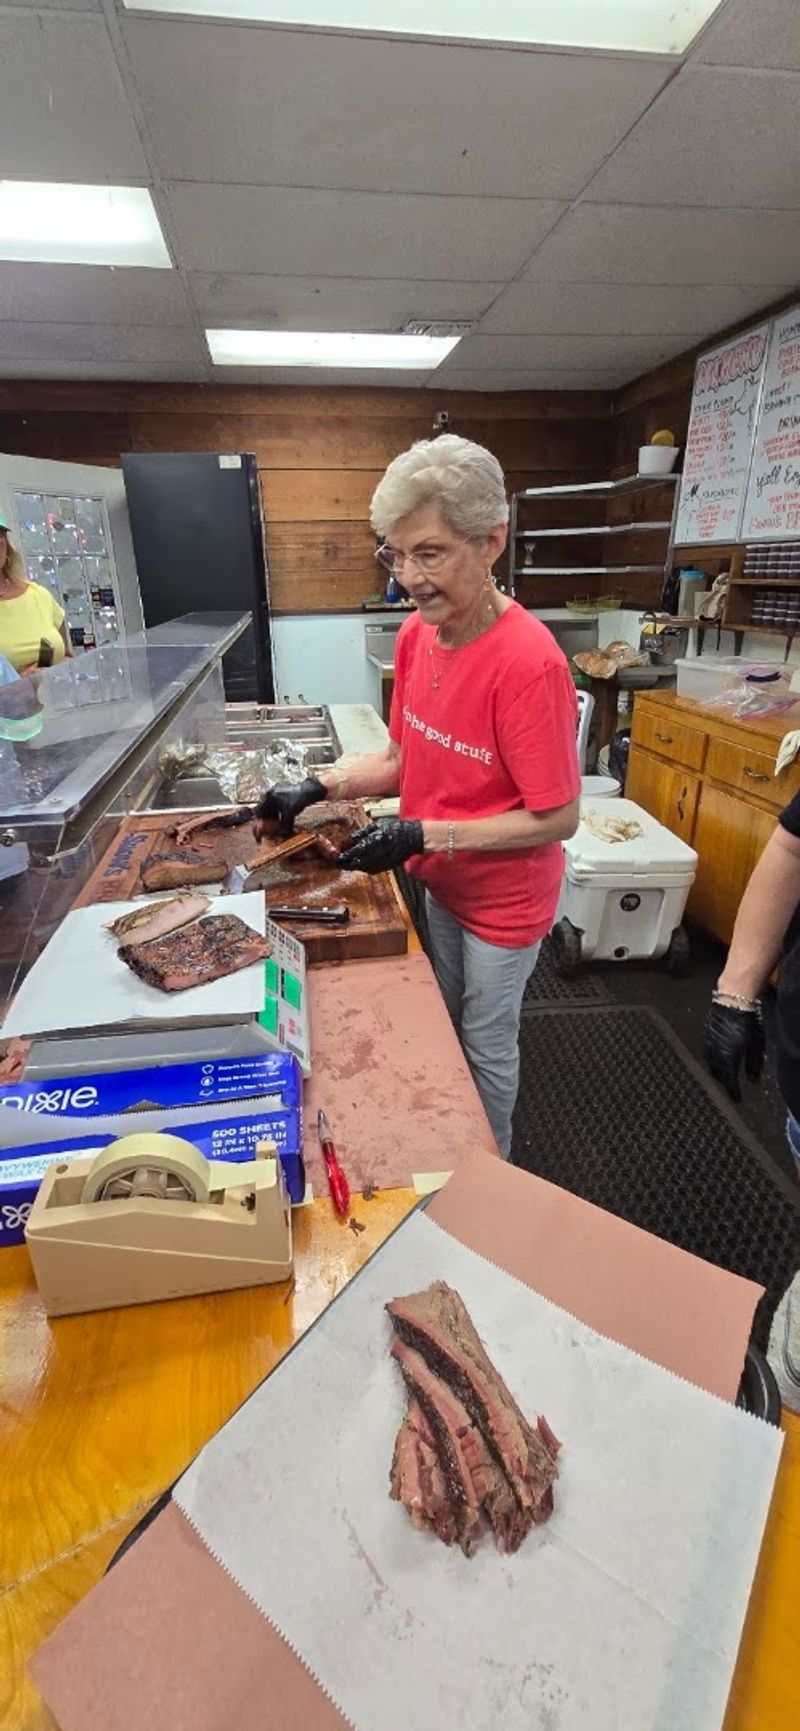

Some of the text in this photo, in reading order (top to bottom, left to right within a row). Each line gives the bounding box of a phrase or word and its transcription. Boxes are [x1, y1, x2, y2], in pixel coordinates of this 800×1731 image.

[425, 726, 452, 749] good
[453, 740, 494, 766] stuff
[212, 1120, 287, 1138] 500 SHEETS
[212, 1140, 223, 1148] 12
